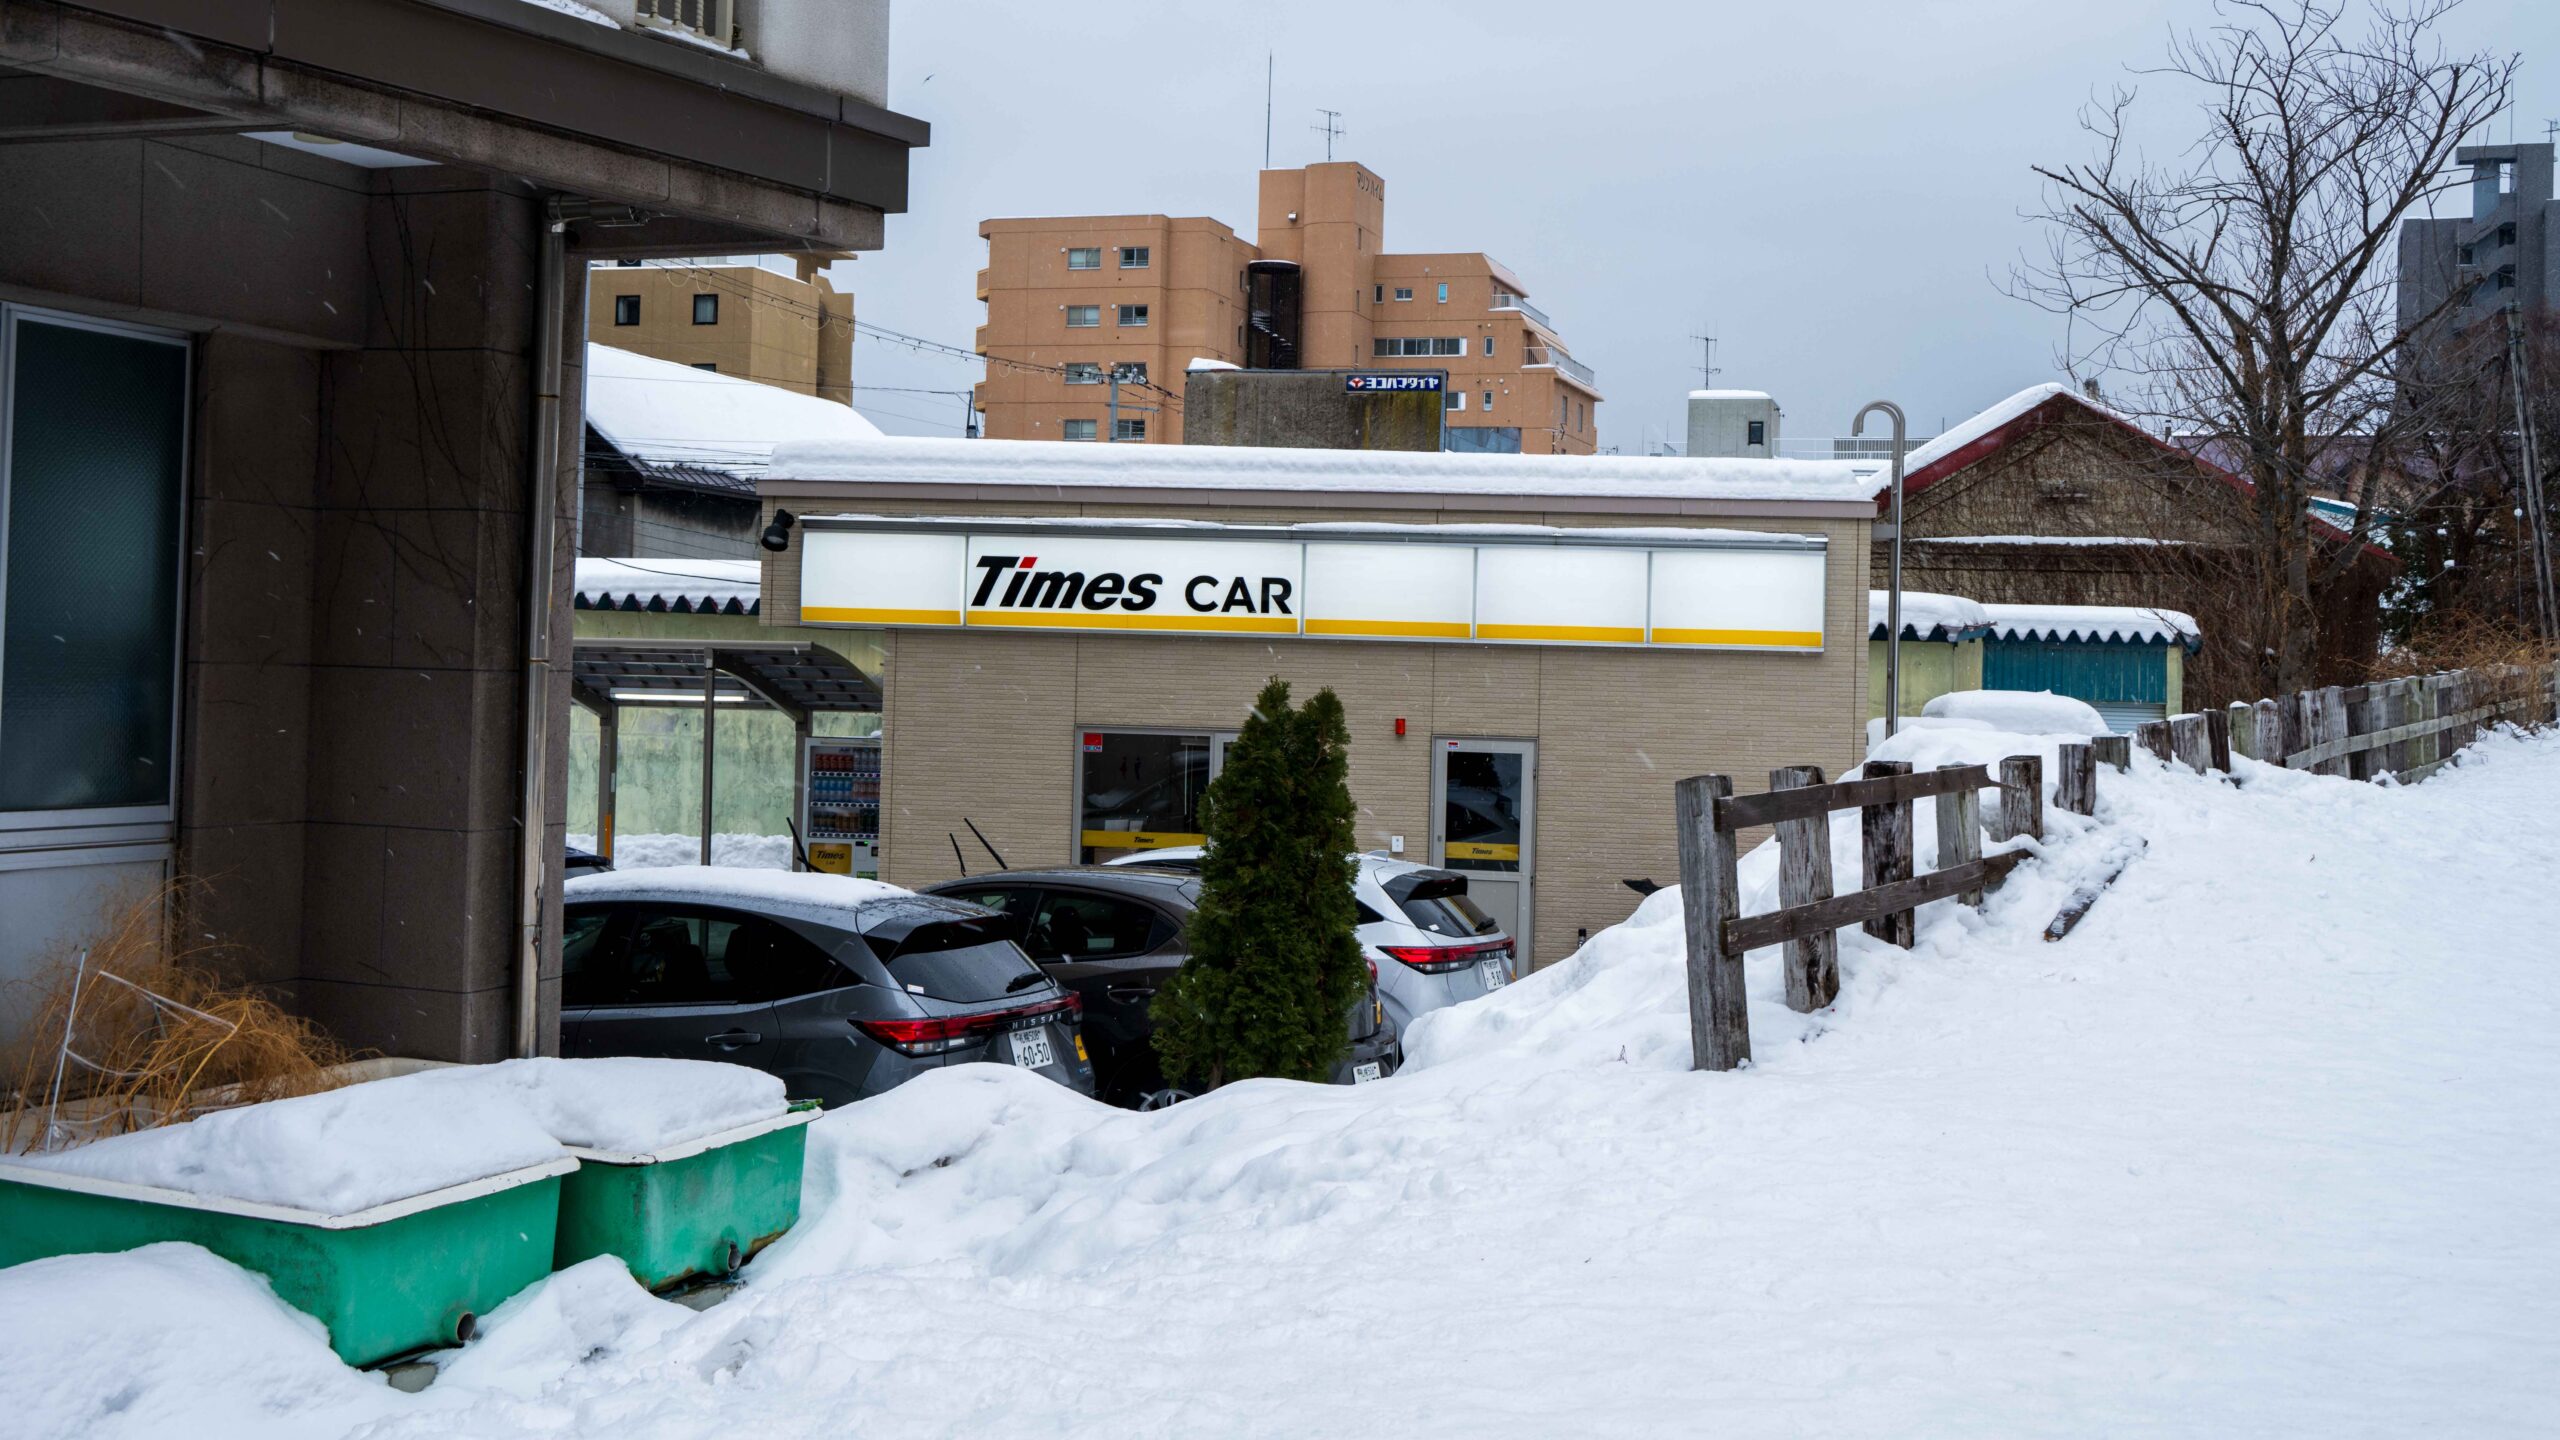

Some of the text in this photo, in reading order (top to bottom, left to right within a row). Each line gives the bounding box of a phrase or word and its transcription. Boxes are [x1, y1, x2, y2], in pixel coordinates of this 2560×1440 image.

[1366, 377, 1439, 389] ヨコハマタイヤ
[970, 555, 1293, 614] Times CAR
[1134, 836, 1154, 844] Times
[817, 850, 845, 859] Times
[1472, 847, 1493, 855] Times
[1012, 1012, 1061, 1029] NISSAN
[1023, 1042, 1050, 1066] 60-50
